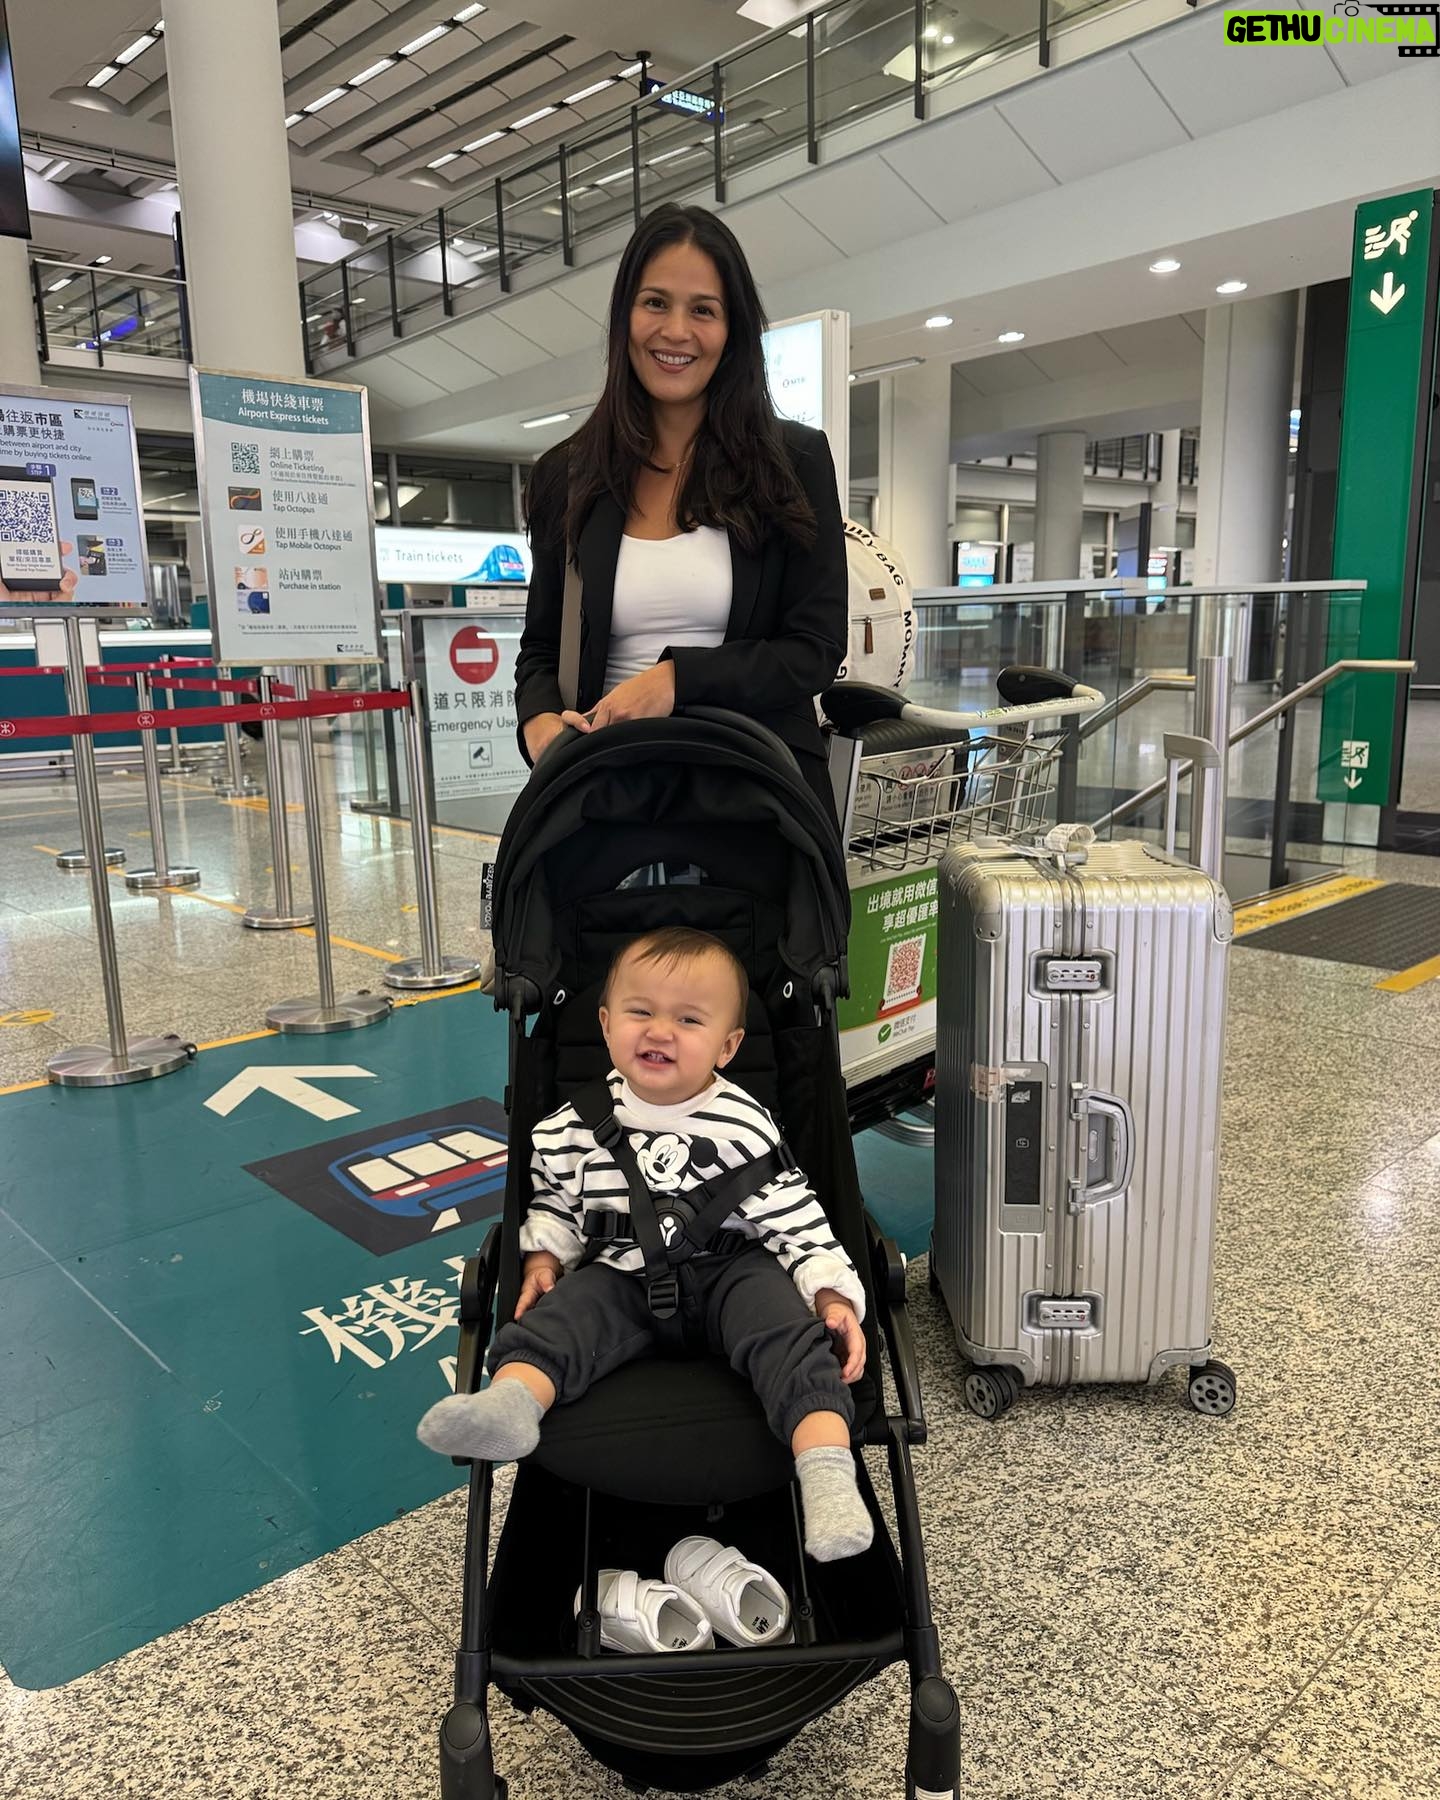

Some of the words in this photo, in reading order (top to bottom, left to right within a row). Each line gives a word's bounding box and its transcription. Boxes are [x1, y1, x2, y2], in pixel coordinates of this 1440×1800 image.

[238, 407, 269, 419] Airport
[269, 410, 301, 422] Express
[302, 414, 329, 425] tickets
[0, 424, 65, 441] 購票更快捷
[31, 442, 54, 451] airport
[14, 449, 23, 458] by
[24, 450, 48, 460] buying
[48, 452, 71, 460] tickets
[270, 461, 293, 469] Online
[293, 462, 325, 473] Ticketing
[273, 504, 286, 513] Tap
[287, 505, 315, 514] Octopus
[276, 540, 288, 549] Tap
[289, 541, 312, 549] Mobile
[314, 542, 342, 551] Octopus
[396, 549, 424, 561] Train
[426, 551, 464, 563] tickets
[876, 553, 904, 586] BAG
[279, 581, 309, 590] Purchase
[310, 582, 318, 590] in
[893, 610, 913, 688] MOMMY
[430, 719, 493, 733] Emergency
[496, 716, 517, 728] Use
[867, 878, 938, 913] 出境就用微信
